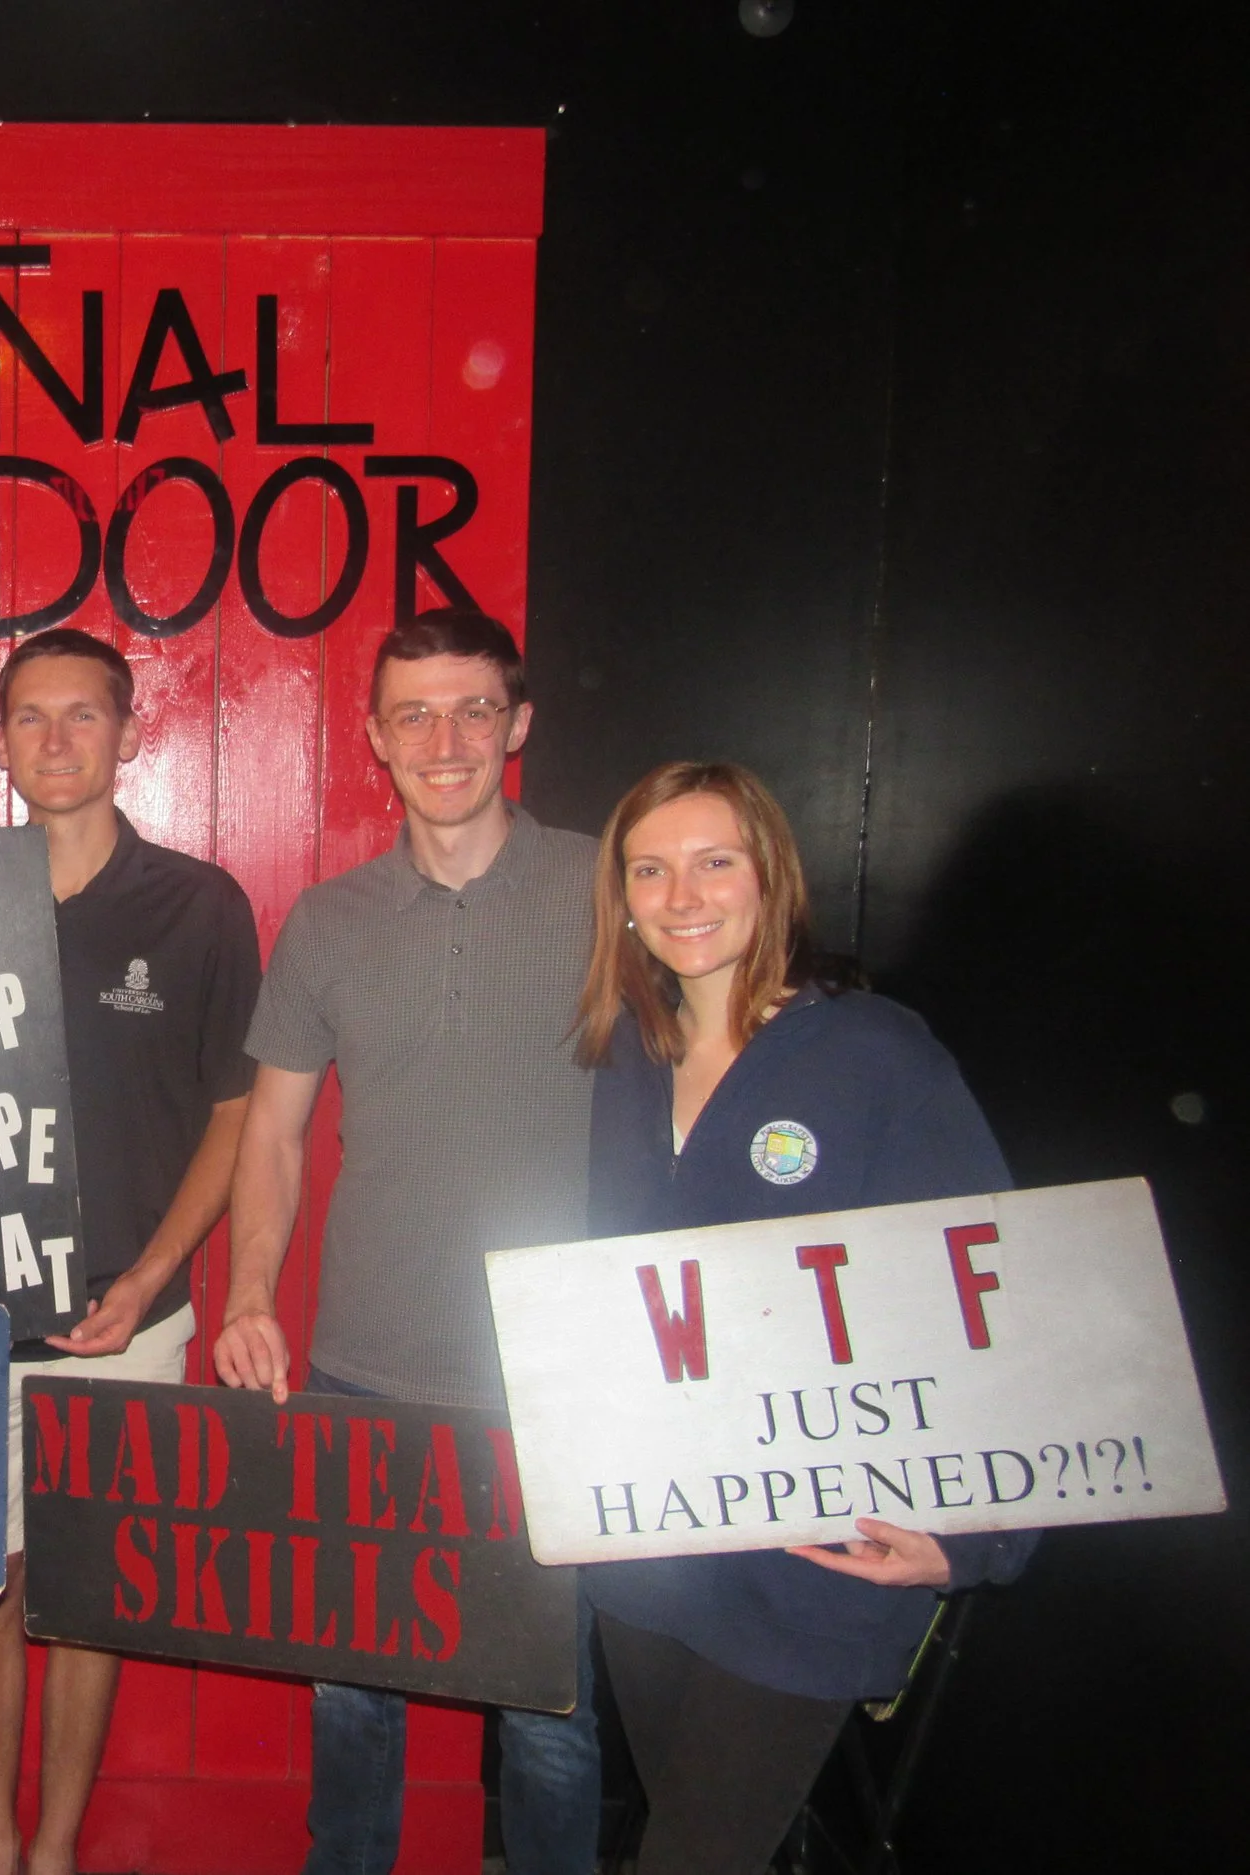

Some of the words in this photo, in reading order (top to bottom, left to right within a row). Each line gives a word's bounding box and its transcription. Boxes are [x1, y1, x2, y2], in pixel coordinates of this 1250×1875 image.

[100, 992, 128, 1003] SOUTH
[129, 995, 164, 1009] CAROLINA
[30, 1393, 231, 1510] MAD
[757, 1376, 937, 1446] JUST
[593, 1436, 1154, 1536] HAPPENED?!?!
[114, 1515, 462, 1663] SKILLS
